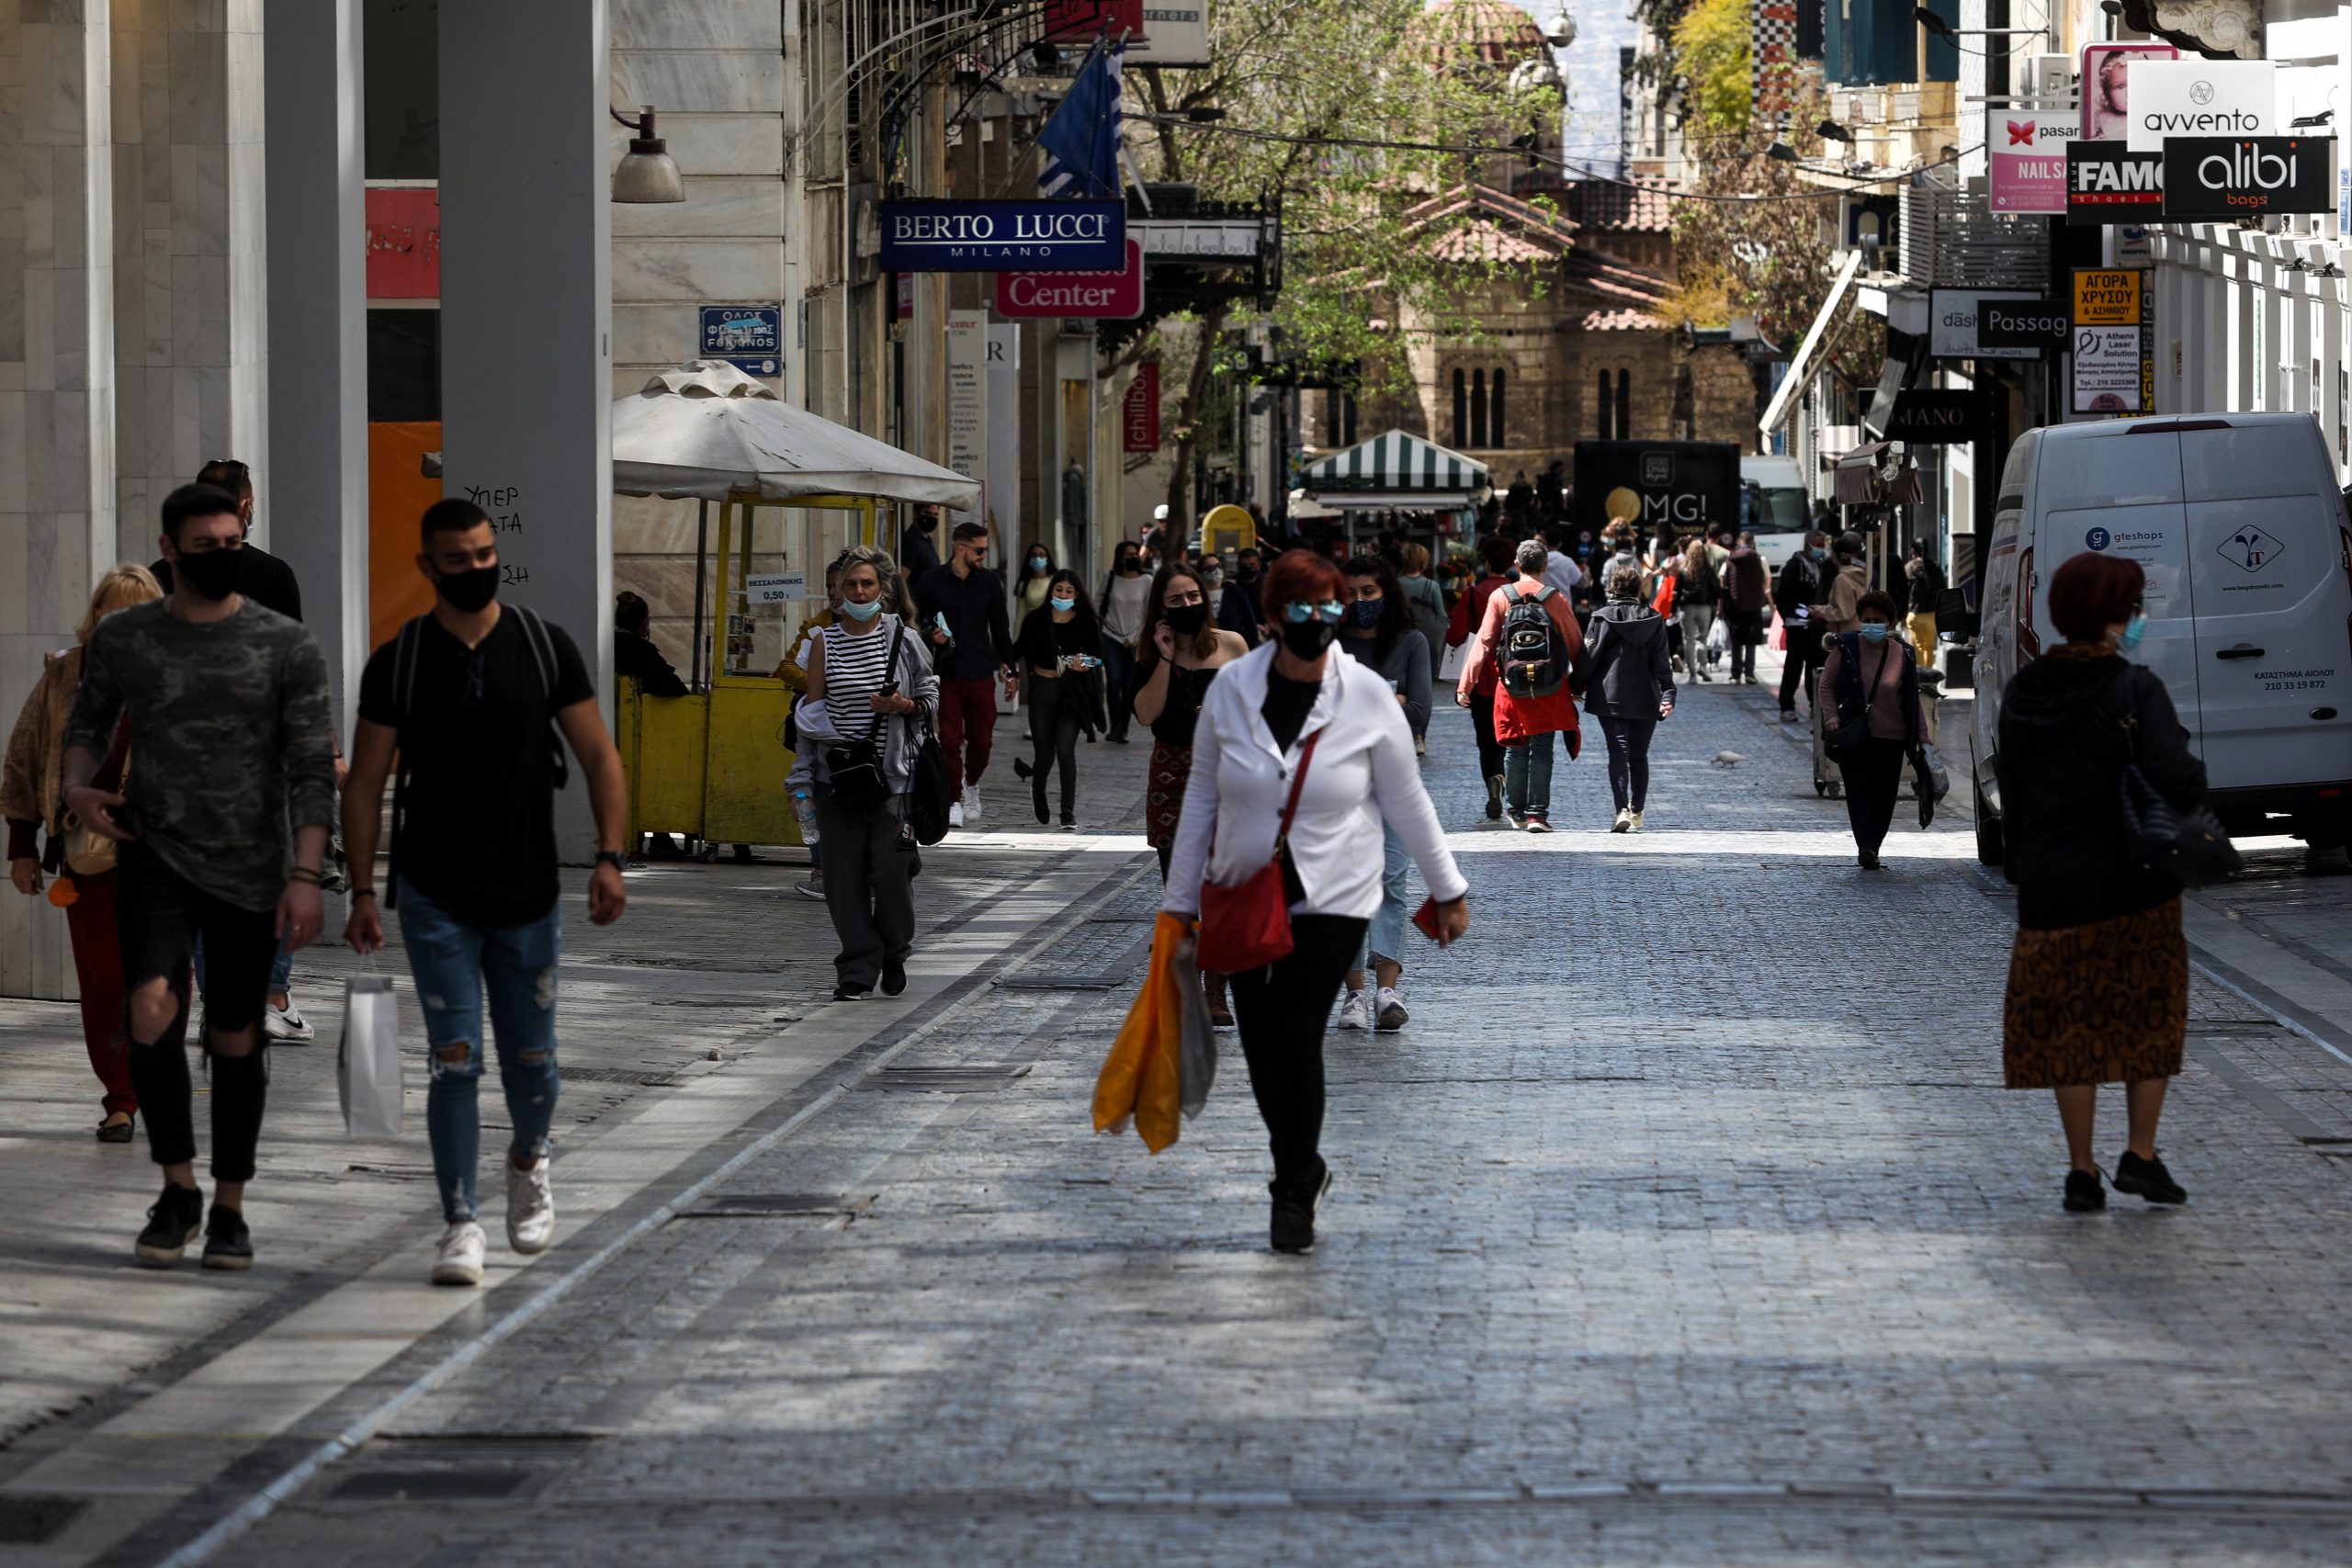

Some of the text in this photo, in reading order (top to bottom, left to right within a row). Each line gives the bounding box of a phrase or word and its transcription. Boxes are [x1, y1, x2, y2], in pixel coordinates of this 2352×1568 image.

[2144, 108, 2259, 131] avvento
[2018, 162, 2051, 179] NAIL
[2198, 141, 2297, 189] alibi
[2227, 193, 2268, 208] bags
[894, 214, 994, 239] BERTO
[951, 247, 1052, 257] MILANO
[2086, 275, 2129, 288] ΑΓΟΡΑ
[1009, 276, 1116, 307] Center
[2081, 290, 2132, 303] ΧΡΥΣΟΥ
[1128, 367, 1148, 442] chillbox
[1886, 407, 1964, 425] MANO
[2114, 532, 2163, 543] gteshops
[763, 591, 785, 601] 0,50
[2254, 669, 2335, 680] ΚΑΤΑΣΤΗΜΑ ΑΙΟΛΟΥ
[2265, 680, 2326, 691] 210 33 19 872
